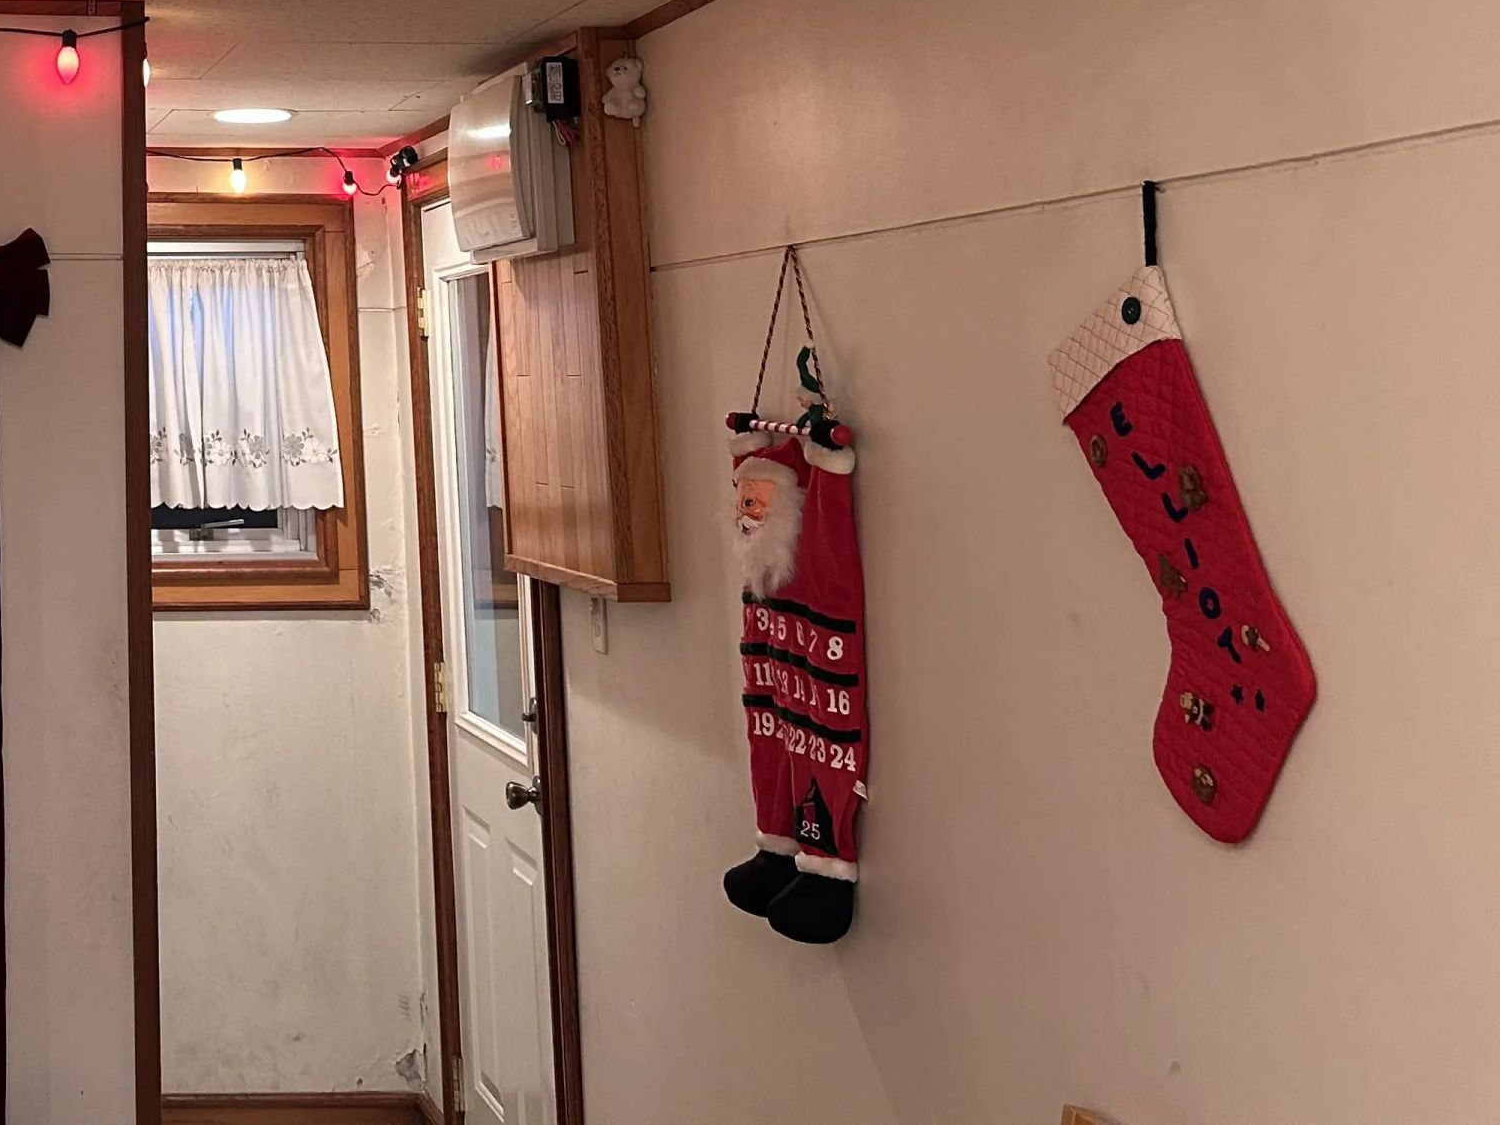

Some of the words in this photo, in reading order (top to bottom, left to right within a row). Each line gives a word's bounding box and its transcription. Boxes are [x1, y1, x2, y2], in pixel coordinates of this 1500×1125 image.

[1110, 401, 1242, 665] ELLIOT
[756, 607, 770, 631] 3
[777, 616, 787, 641] 5
[809, 629, 818, 653] 7
[826, 636, 844, 661] 8
[753, 662, 774, 687] 11
[826, 689, 850, 715] 16
[753, 711, 775, 737] 19
[789, 726, 807, 755] 22
[808, 734, 826, 763] 23
[830, 744, 856, 772] 24
[800, 820, 821, 840] 25
